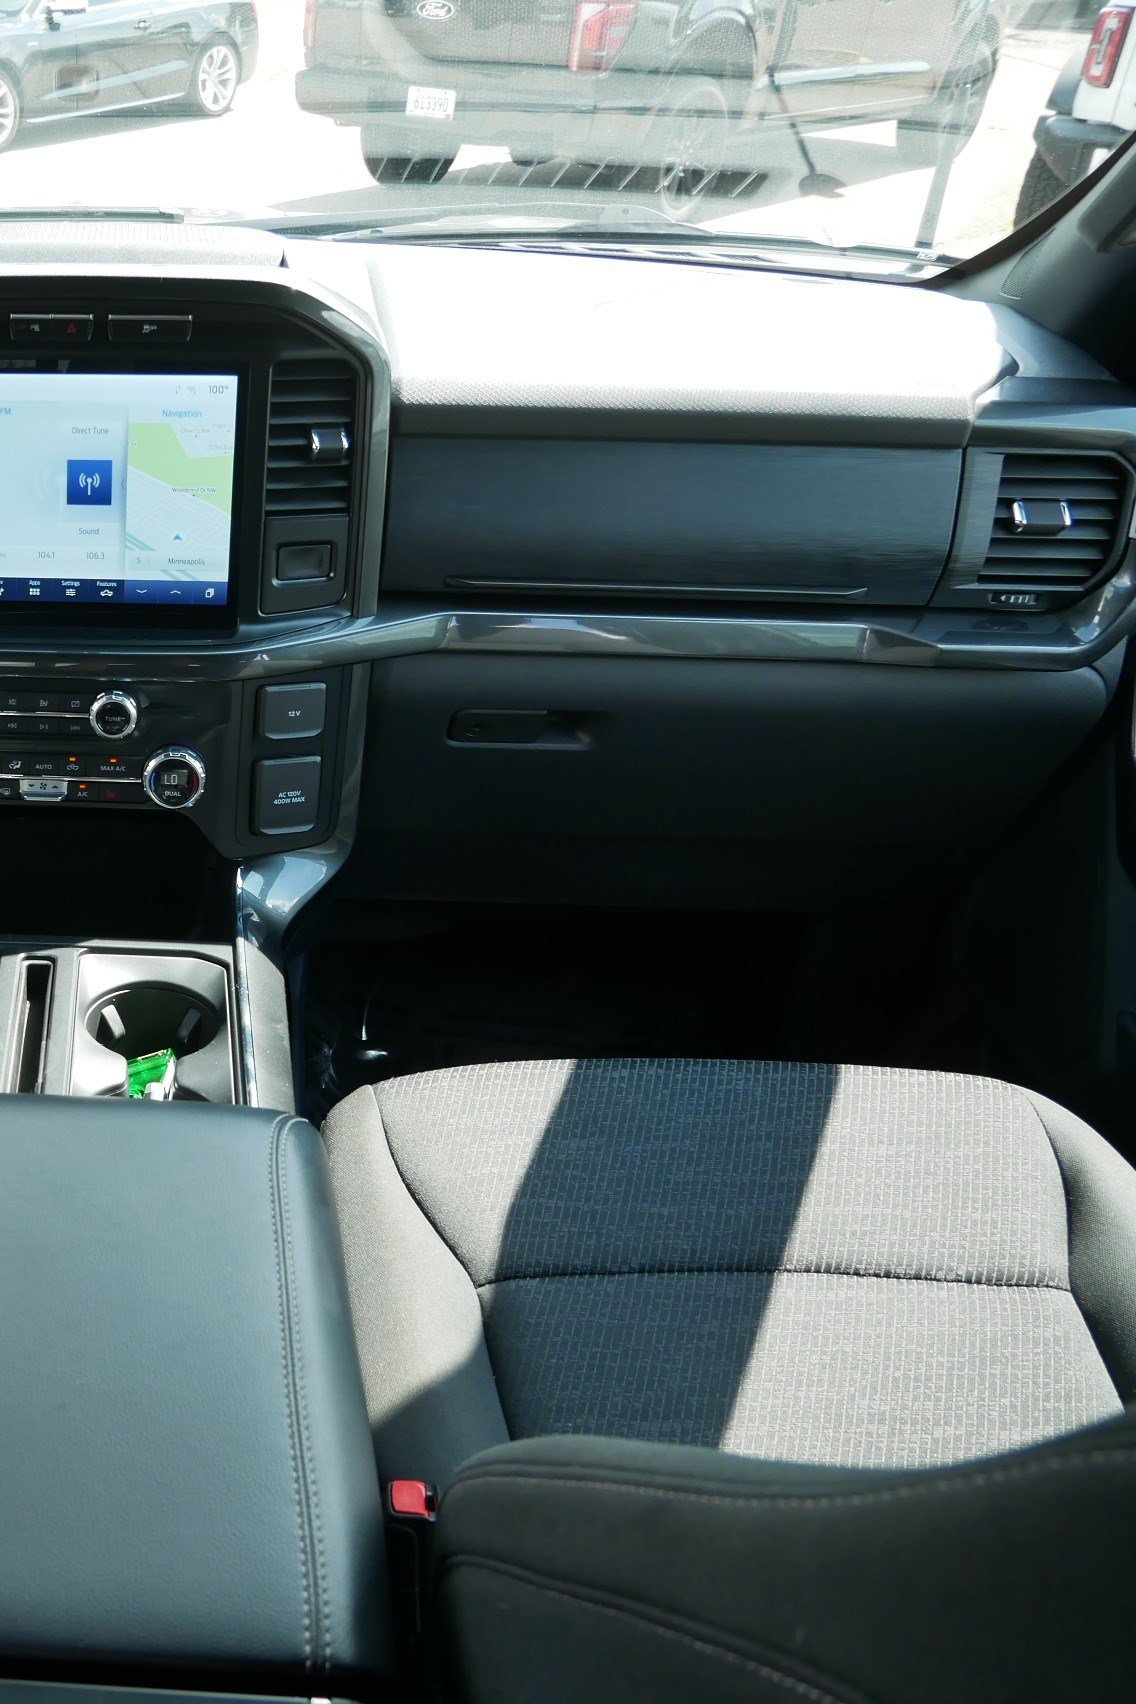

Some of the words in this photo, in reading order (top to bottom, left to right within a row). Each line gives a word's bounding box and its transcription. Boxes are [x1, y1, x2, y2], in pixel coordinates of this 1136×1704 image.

[423, 2, 448, 16] Ford
[208, 385, 229, 394] 100°
[0, 407, 11, 416] FM
[162, 409, 202, 419] Navigation
[71, 426, 91, 435] Direct
[92, 427, 109, 435] Tune
[86, 552, 105, 560] 106.3
[168, 558, 205, 566] Minneapolis
